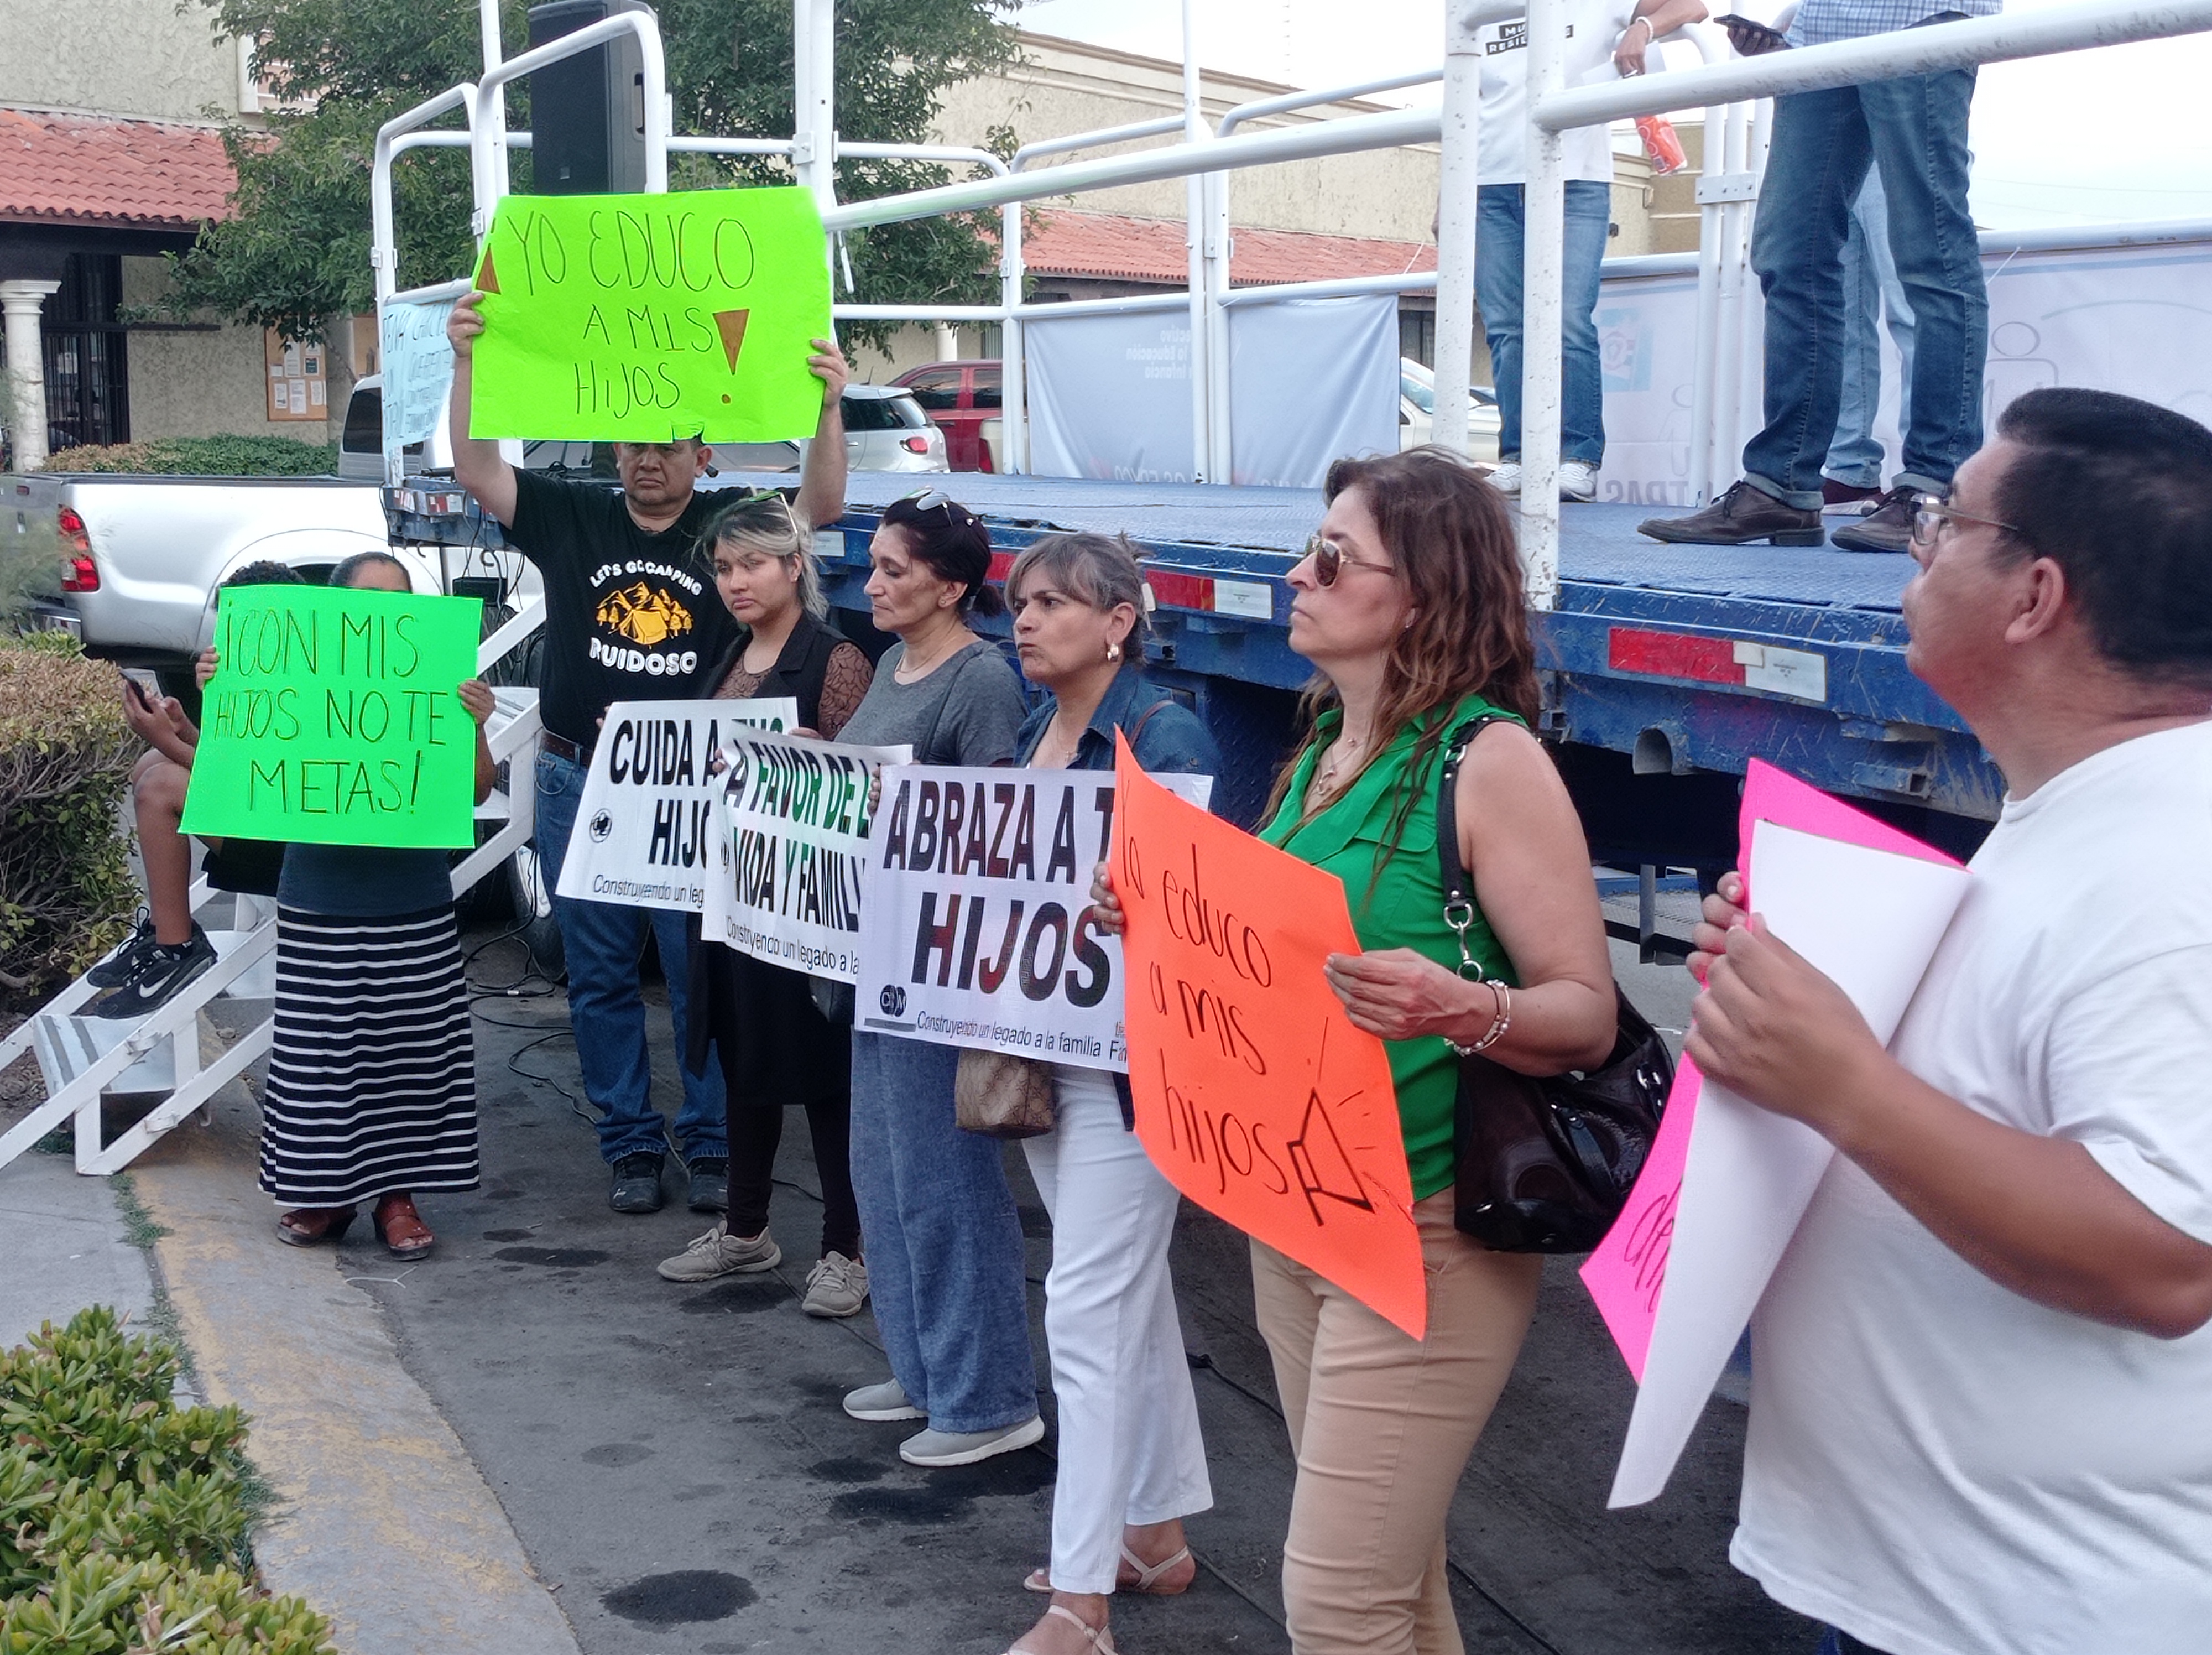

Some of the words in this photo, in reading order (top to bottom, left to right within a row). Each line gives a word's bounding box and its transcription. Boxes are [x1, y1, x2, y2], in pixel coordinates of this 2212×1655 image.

[589, 210, 755, 293] EDUCO
[583, 304, 611, 346] A
[625, 304, 714, 352] MIS
[341, 611, 419, 679] MIS
[589, 637, 698, 676] RUIDOSO
[214, 688, 301, 741] HIJOS
[325, 688, 389, 743] NO
[401, 689, 448, 746] TE
[249, 749, 424, 815] METAS!
[609, 719, 695, 787] CUIDA
[702, 719, 719, 787] A
[722, 738, 750, 809] A
[748, 740, 823, 826] FAVOR
[823, 752, 857, 835] DE
[857, 758, 881, 840] L
[883, 780, 1035, 881] ABRAZA
[1046, 785, 1076, 884] A
[593, 874, 671, 902] Construyendo
[674, 887, 686, 902] un
[689, 883, 705, 909] leg
[733, 826, 778, 913] VIDA
[782, 837, 798, 916] Y
[1162, 842, 1271, 988] educo
[782, 940, 795, 960] un
[797, 938, 836, 971] legado
[839, 954, 847, 971] a
[849, 950, 860, 975] la
[910, 891, 1113, 1008] HIJOS
[917, 1010, 978, 1039] Construyendo
[978, 1023, 990, 1038] un
[990, 1021, 1032, 1047] legado
[1034, 1033, 1043, 1048] a
[1045, 1029, 1055, 1050] la
[1058, 1031, 1102, 1057] familia
[1150, 960, 1167, 1016] a
[1178, 978, 1266, 1075] mis
[1159, 1047, 1289, 1196] hijos
